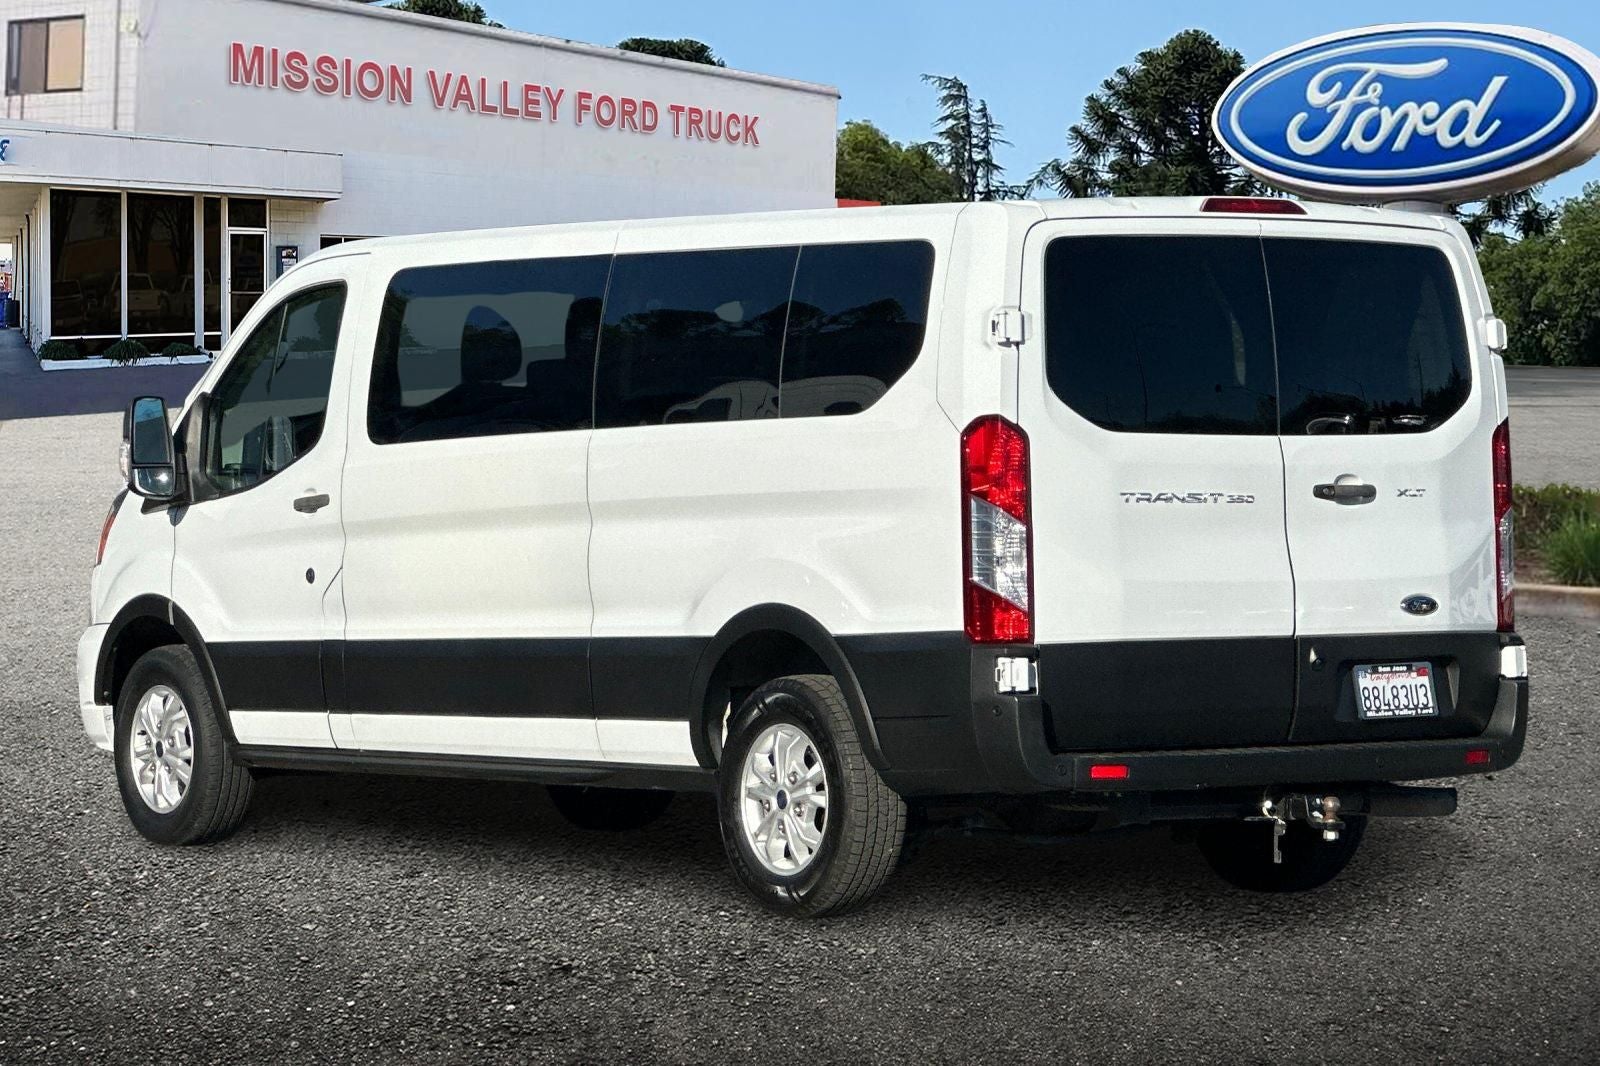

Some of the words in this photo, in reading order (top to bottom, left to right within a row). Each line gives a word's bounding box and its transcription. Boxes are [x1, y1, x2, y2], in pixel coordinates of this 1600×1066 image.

[229, 41, 413, 105] MISSION
[426, 69, 565, 122] VALLEY
[575, 90, 660, 135] FORD
[668, 104, 762, 147] TRUCK
[1286, 57, 1509, 156] Ford
[1120, 492, 1225, 504] TRANSIT
[1396, 488, 1426, 498] XLT
